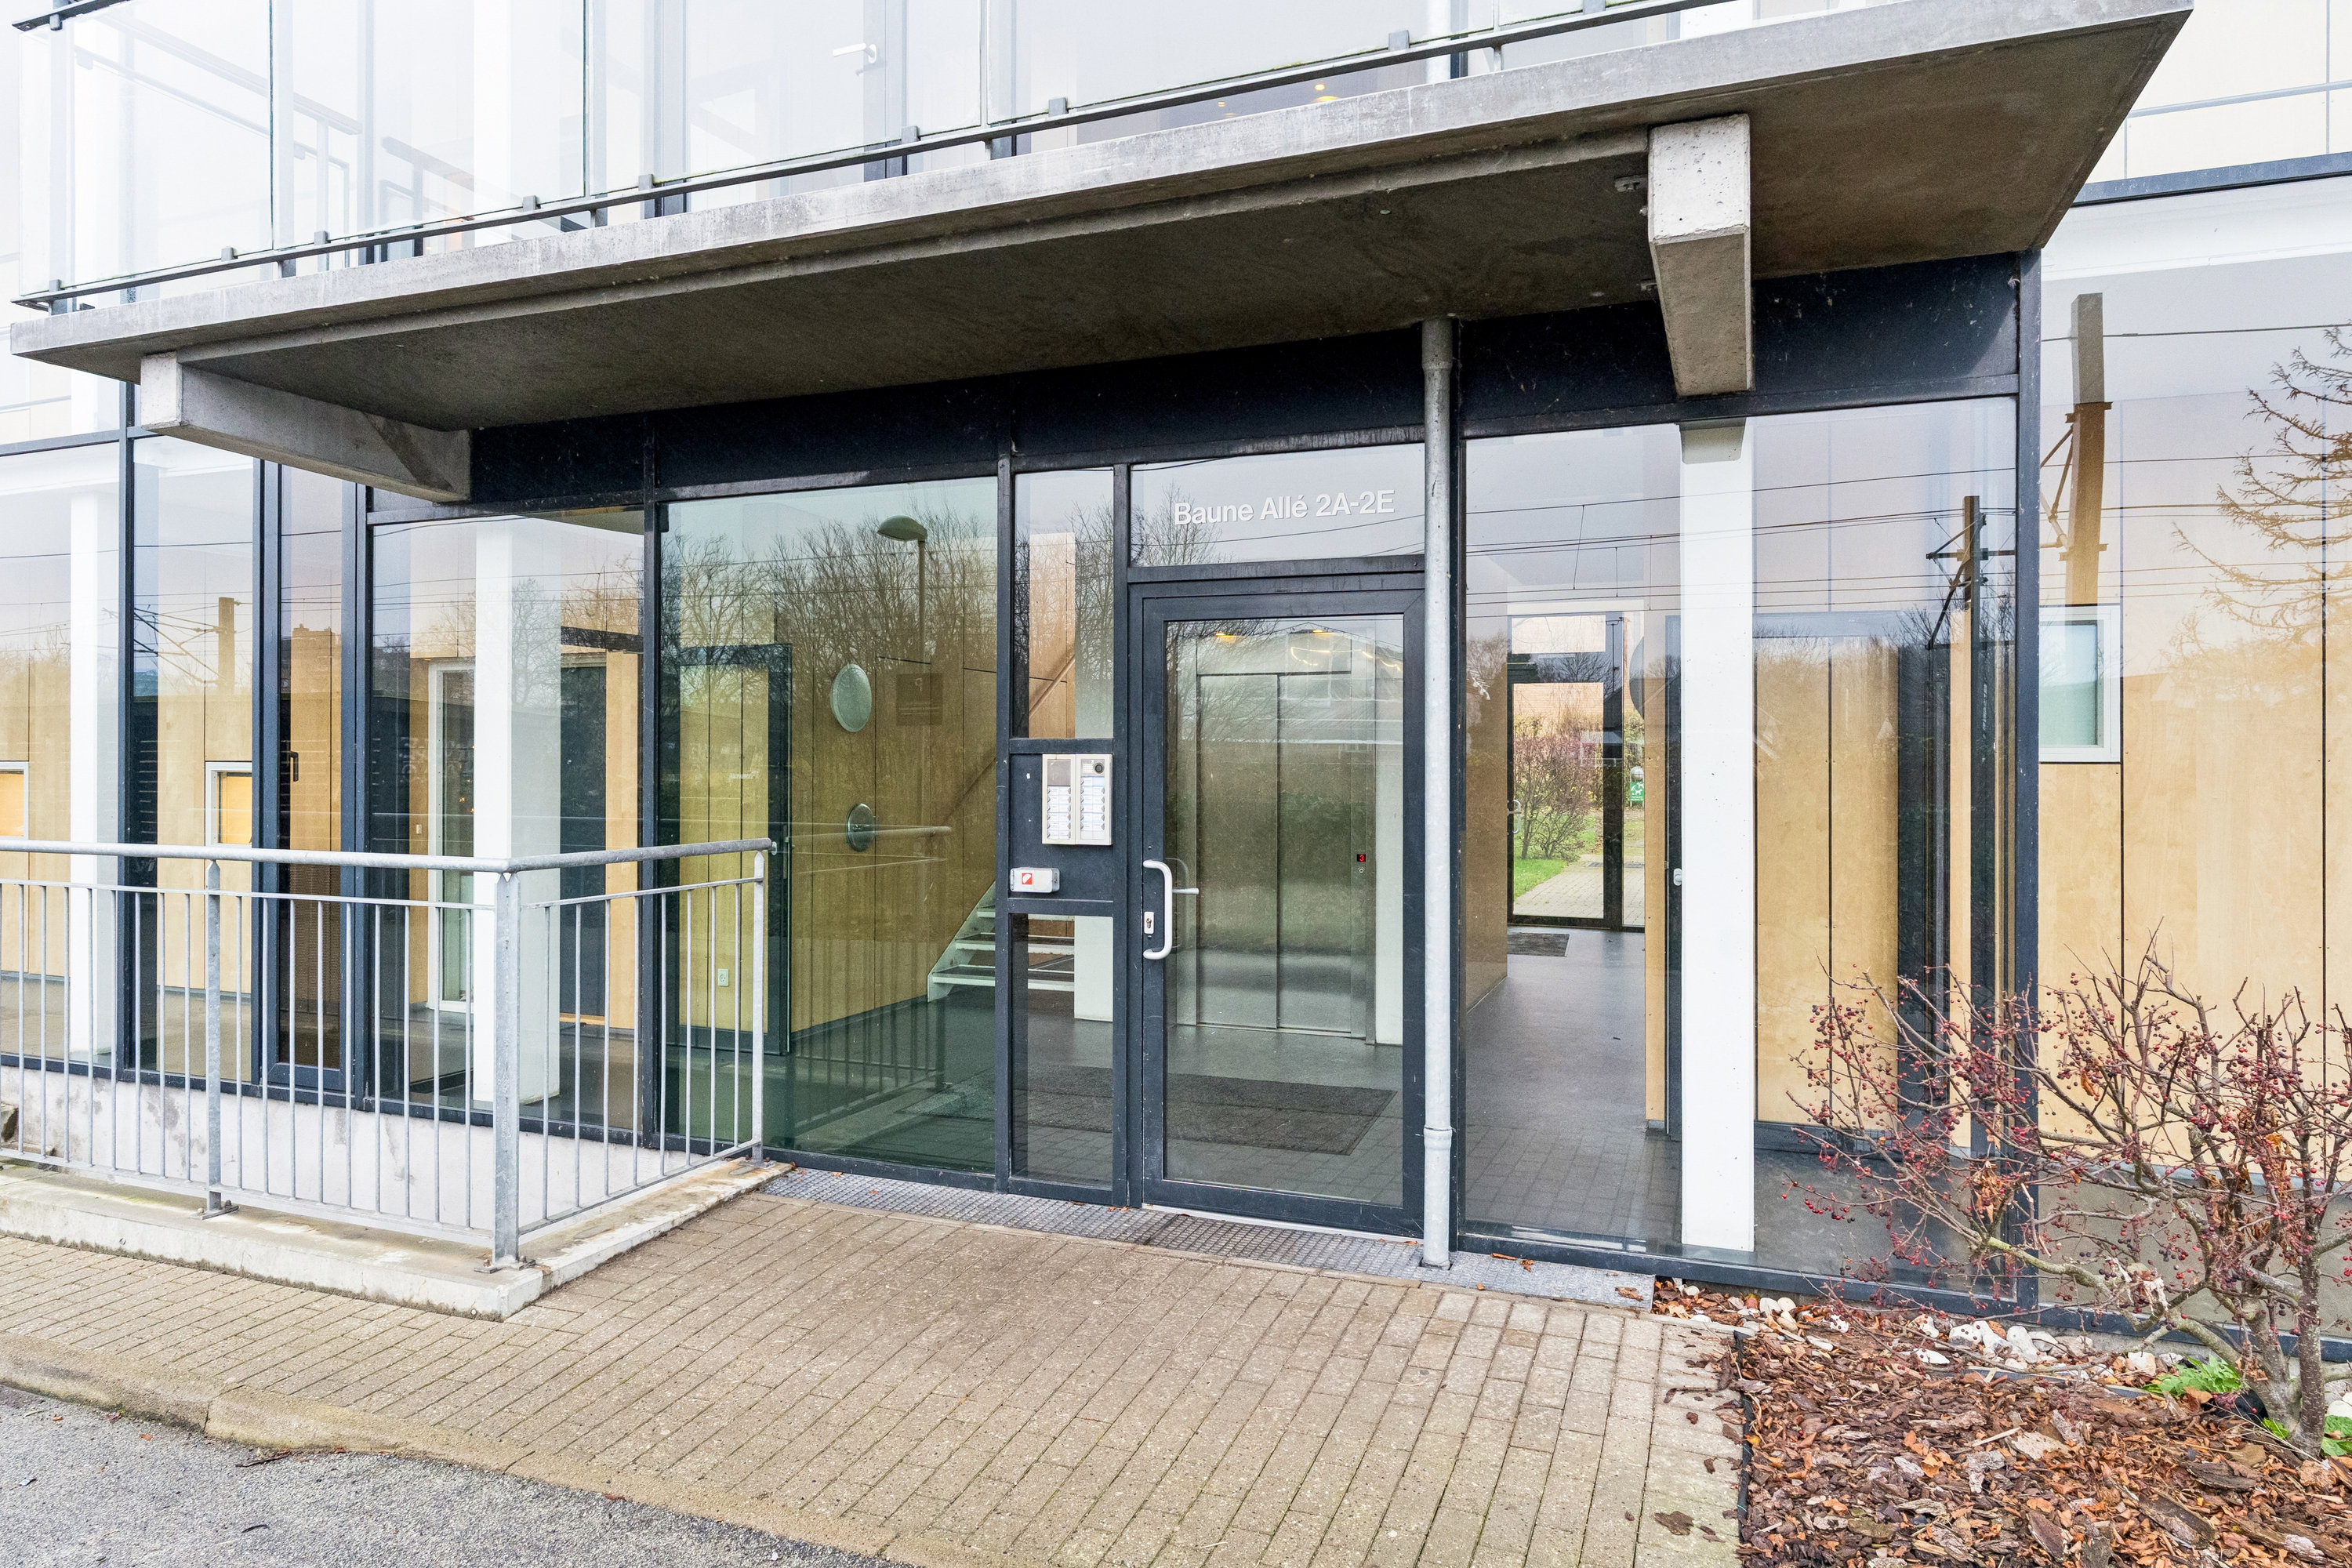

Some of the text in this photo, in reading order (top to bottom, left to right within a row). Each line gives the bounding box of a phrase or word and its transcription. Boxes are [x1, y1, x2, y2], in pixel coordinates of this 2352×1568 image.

[1174, 490, 1395, 525] Baune Allé 2A-2E
